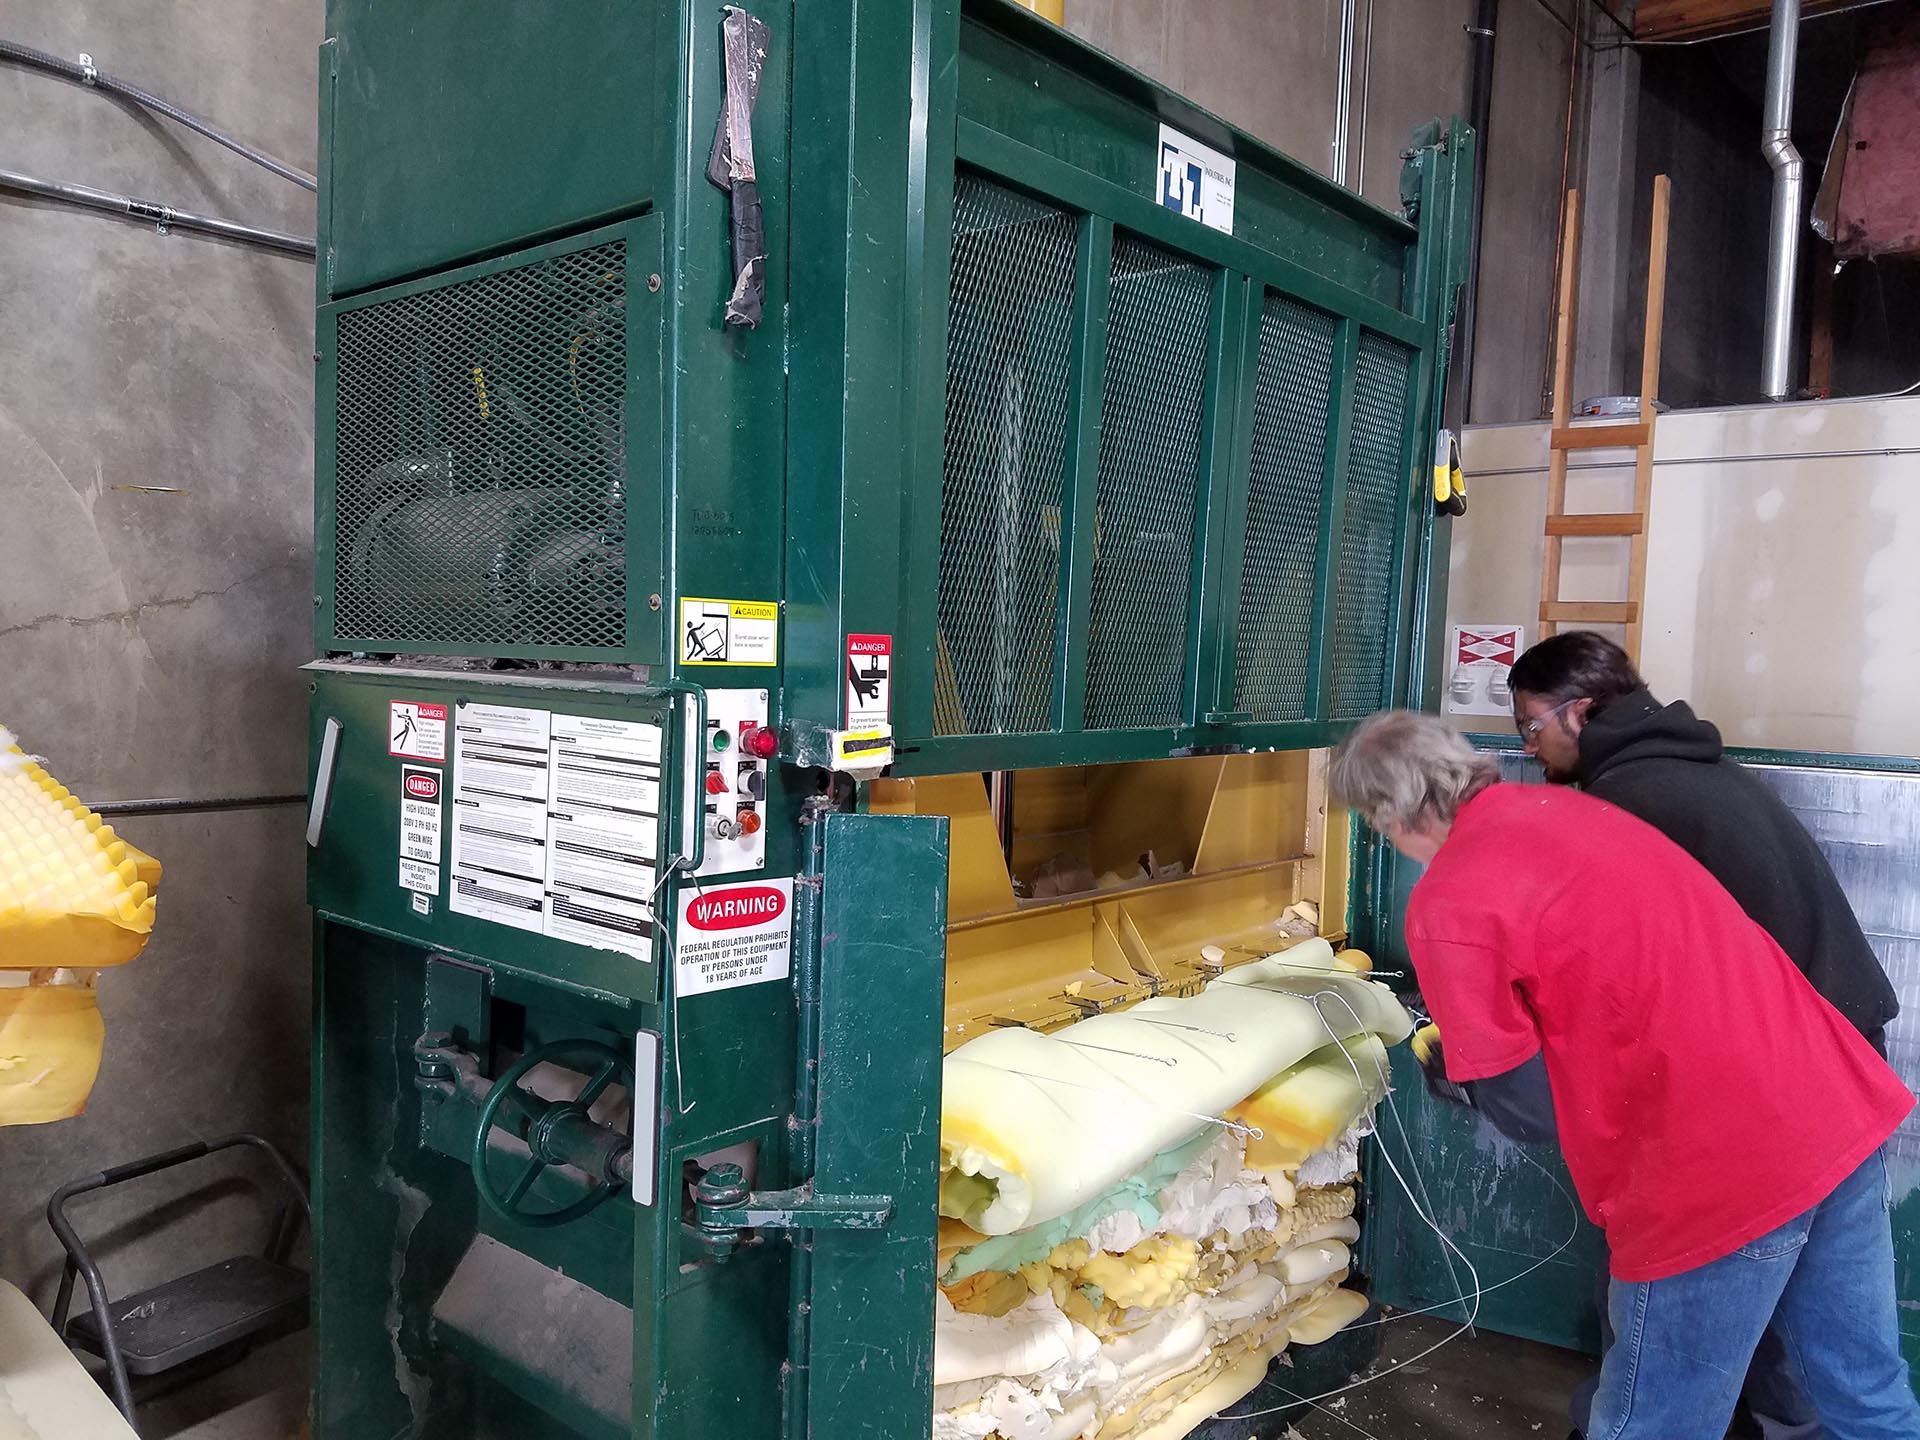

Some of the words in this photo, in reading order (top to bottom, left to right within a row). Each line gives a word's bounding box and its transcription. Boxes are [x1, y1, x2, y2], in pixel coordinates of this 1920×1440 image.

[742, 607, 772, 617] CAUTION
[858, 643, 886, 652] DANGER
[422, 708, 444, 718] DANGER
[409, 778, 435, 793] DANGER
[406, 803, 417, 813] HIGH
[417, 805, 436, 817] VOLTAGE
[419, 820, 425, 829] PH
[432, 822, 438, 832] HZ
[408, 832, 421, 843] GREEN
[422, 835, 433, 846] WIRE
[408, 846, 413, 856] TO
[414, 848, 432, 860] GROUND
[402, 862, 416, 871] RESET
[417, 866, 437, 876] BUTTON
[411, 872, 426, 881] INSIDE
[405, 878, 415, 887] THIS
[416, 881, 432, 891] COVER
[696, 895, 778, 921] WARNING
[680, 942, 710, 955] FEDERAL
[712, 935, 754, 949] REGULATION
[755, 930, 789, 942] PROHIBITS
[680, 952, 720, 966] OPERATION
[722, 949, 731, 959] OF
[733, 947, 749, 957] THIS
[750, 941, 788, 954] EQUIPMENT
[701, 964, 711, 973] BY
[712, 958, 744, 972] PERSONS
[745, 954, 768, 966] UNDER
[706, 974, 714, 983] 18
[716, 970, 737, 982] YEARS
[739, 969, 748, 978] OF
[749, 966, 763, 975] AGE
